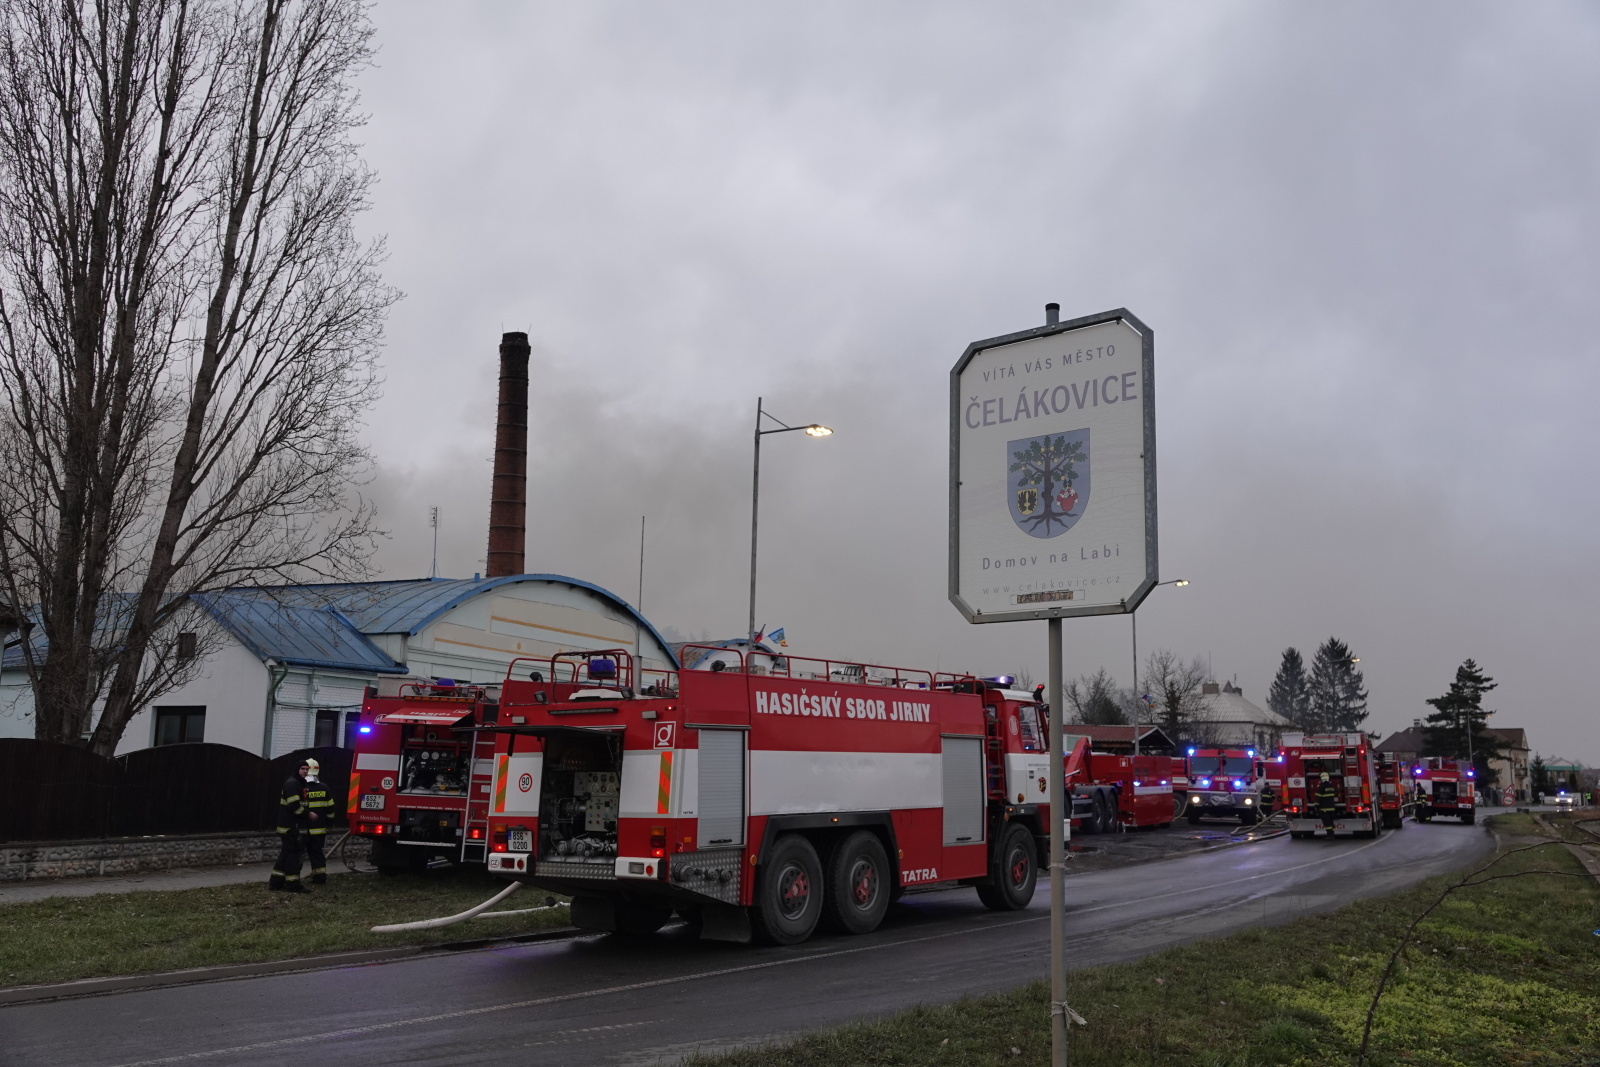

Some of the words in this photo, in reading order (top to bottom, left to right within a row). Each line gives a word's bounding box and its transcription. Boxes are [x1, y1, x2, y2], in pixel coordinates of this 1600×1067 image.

[983, 363, 1015, 382] VÍTÁ
[1025, 357, 1052, 374] VÁS
[1062, 344, 1115, 366] MĚSTO
[965, 370, 1138, 429] ČELÁKOVICE
[982, 556, 1038, 570] Domov
[1049, 552, 1068, 563] na
[1081, 544, 1120, 560] Labi
[982, 575, 1121, 595] www.celakovice.cz
[755, 687, 842, 718] HASIČSKÝ
[845, 697, 887, 720] SBOR
[889, 700, 931, 723] JIRNY
[521, 776, 530, 786] 90
[512, 831, 524, 841] 8S6
[512, 841, 528, 850] 0200
[901, 867, 938, 883] TATRA
